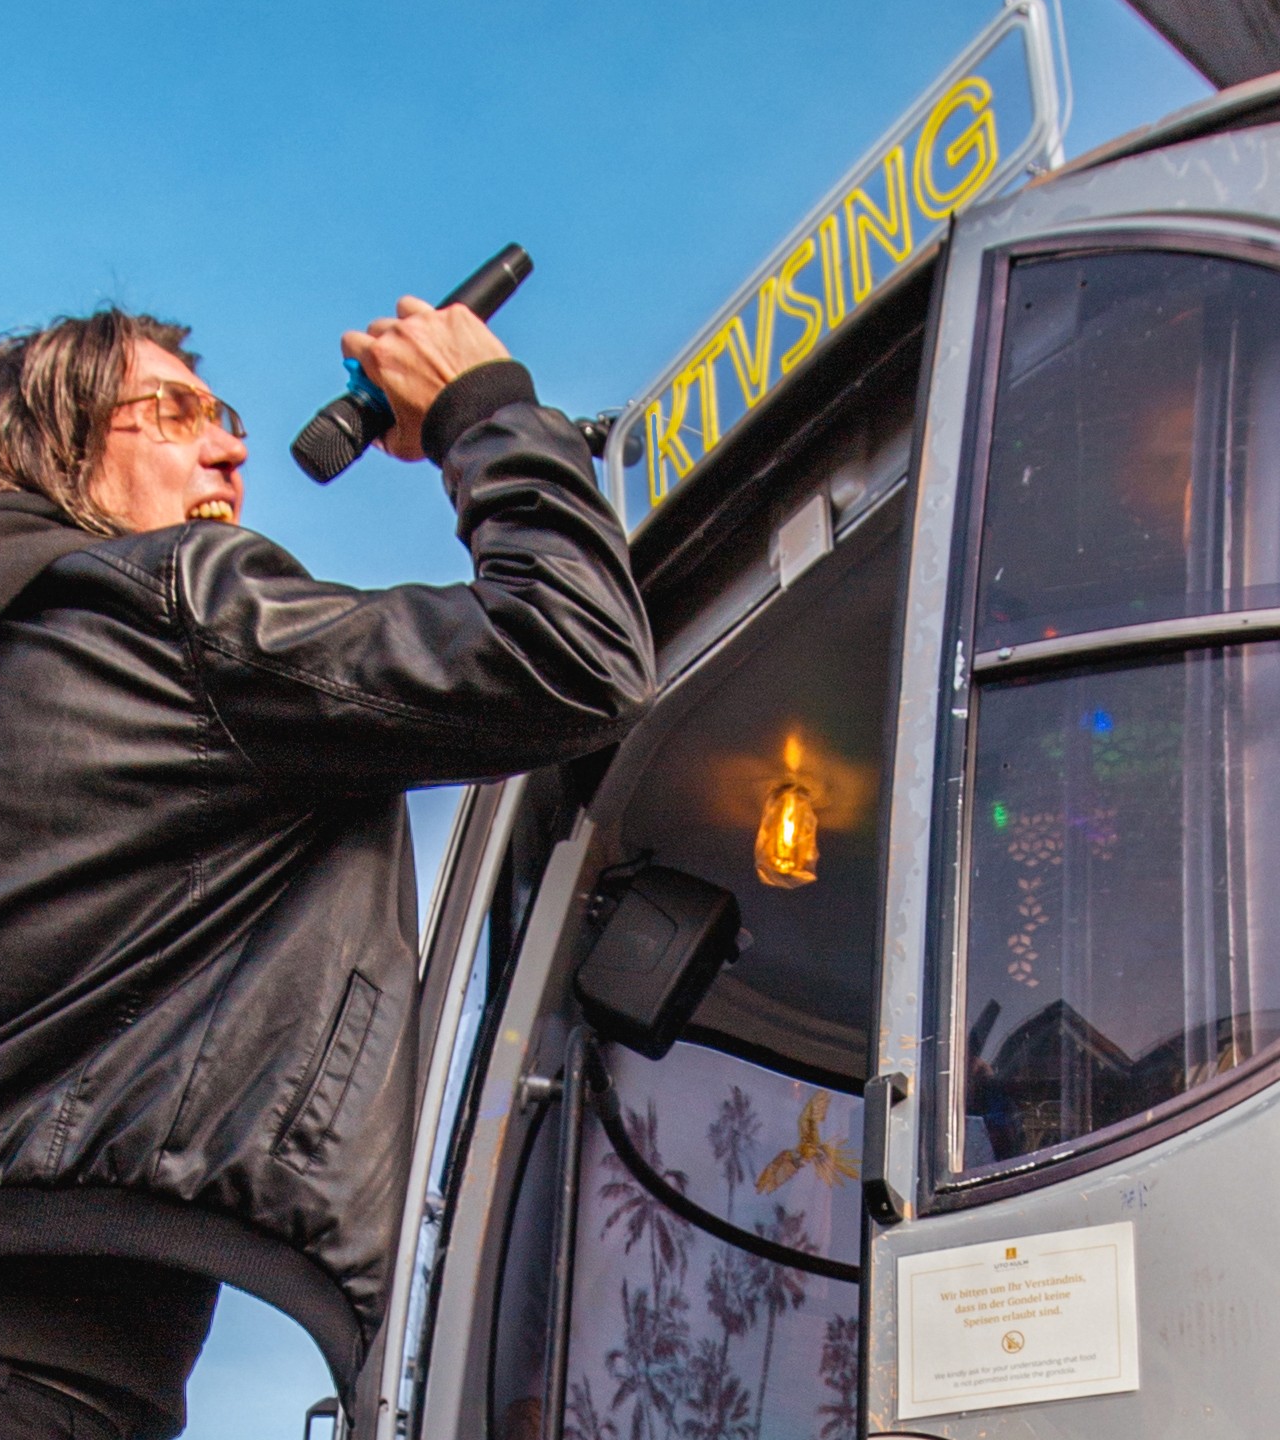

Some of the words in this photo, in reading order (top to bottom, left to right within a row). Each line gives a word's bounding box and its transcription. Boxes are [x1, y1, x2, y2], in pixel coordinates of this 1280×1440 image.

[644, 75, 1000, 508] KTVSING
[940, 1290, 957, 1302] Wir
[959, 1286, 988, 1300] bitten
[990, 1285, 1006, 1295] um
[1008, 1281, 1022, 1292] Ihr
[1024, 1273, 1086, 1290] Verständnis,
[955, 1303, 976, 1314] dass
[977, 1300, 987, 1310] in
[989, 1297, 1006, 1309] der
[1007, 1293, 1042, 1307] Gondel
[1044, 1290, 1071, 1302] keine
[963, 1314, 1000, 1329] Speisen
[1002, 1309, 1036, 1322] erlaubt
[1038, 1305, 1063, 1318] sind.
[934, 1372, 946, 1381] We
[946, 1368, 967, 1381] kindly
[968, 1367, 980, 1377] ask
[980, 1365, 991, 1375] for
[992, 1364, 1009, 1375] your
[1010, 1356, 1062, 1371] understanding
[1063, 1354, 1078, 1365] that
[1079, 1352, 1097, 1363] food
[953, 1380, 960, 1389] is
[960, 1378, 973, 1388] not
[973, 1374, 1009, 1387] permitted
[1009, 1371, 1030, 1382] inside
[1031, 1369, 1044, 1379] the
[1045, 1366, 1076, 1379] gondola.
